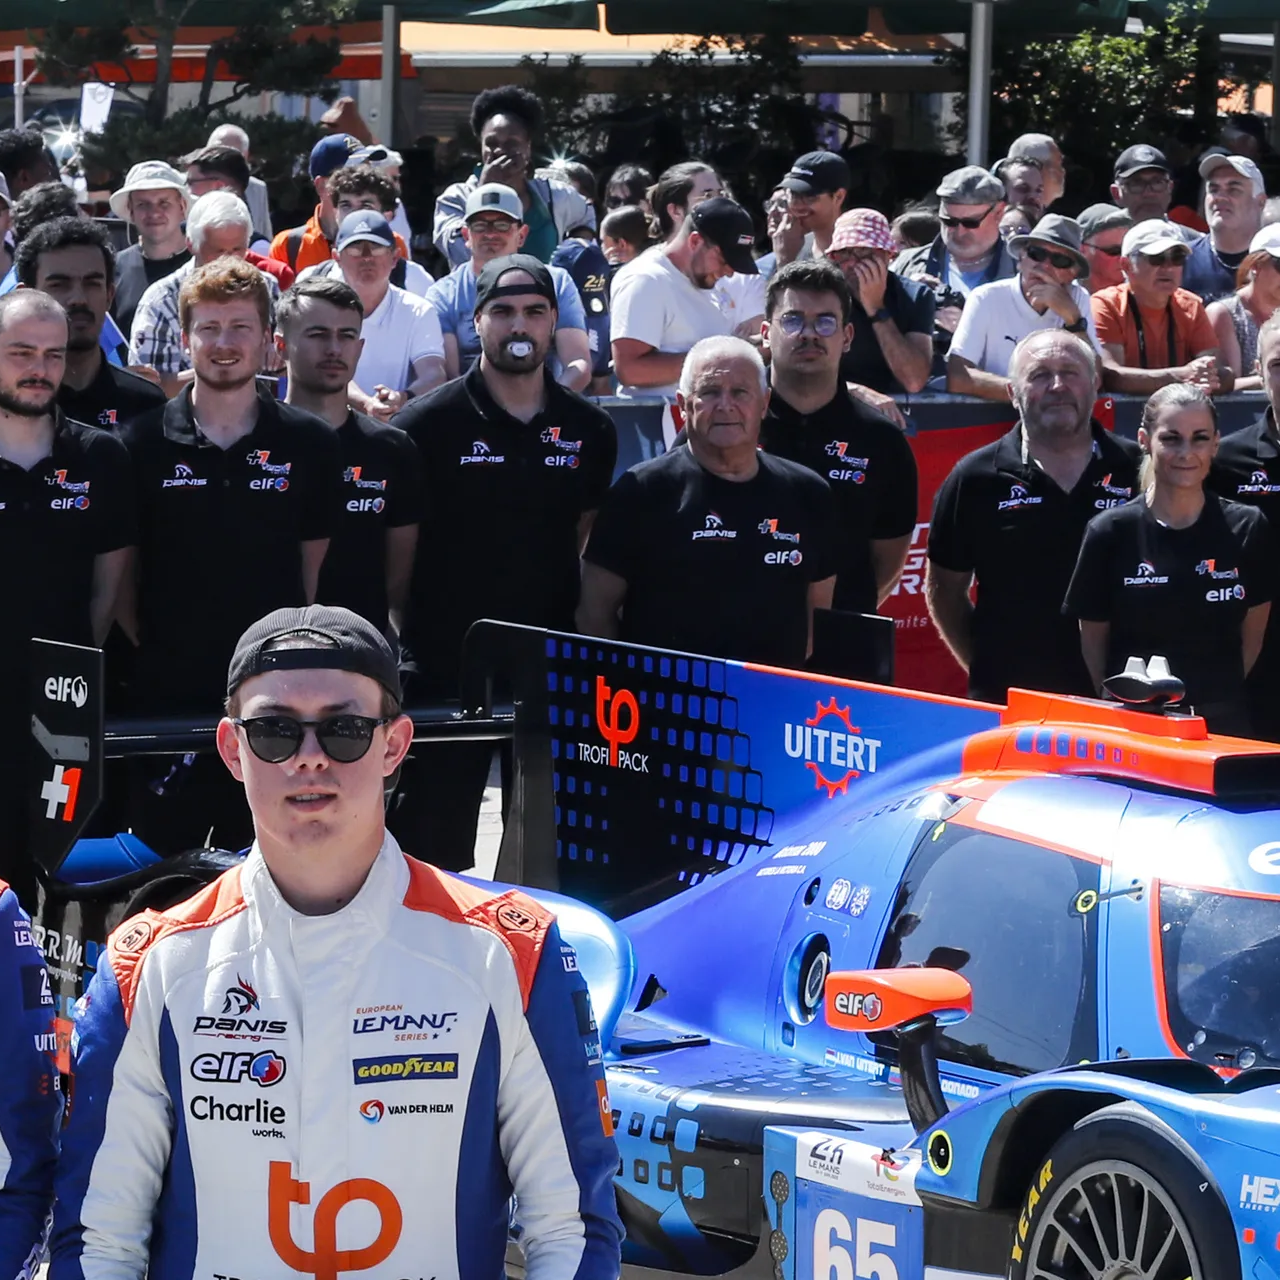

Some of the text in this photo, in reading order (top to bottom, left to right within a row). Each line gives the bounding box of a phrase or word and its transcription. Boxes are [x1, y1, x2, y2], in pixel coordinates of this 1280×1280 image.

[545, 455, 568, 467] elf
[828, 468, 853, 480] elf
[250, 478, 275, 491] elf
[51, 497, 74, 510] elf
[347, 498, 373, 512] elf
[1095, 499, 1118, 510] elf
[764, 550, 791, 565] elf
[1206, 587, 1233, 602] elf
[45, 676, 72, 701] elf
[784, 722, 882, 773] UITERT
[618, 750, 649, 774] PACK
[356, 1004, 404, 1014] EUROPEAN
[834, 992, 864, 1015] elf
[394, 1033, 428, 1042] SERIES
[192, 1052, 250, 1081] elf
[940, 1079, 980, 1099] DONADO
[190, 1095, 286, 1124] Charlie
[388, 1103, 454, 1115] VAN DER HELM
[252, 1128, 286, 1139] works.
[810, 1137, 847, 1166] 24h
[808, 1159, 820, 1169] LE
[820, 1161, 841, 1175] MANS
[866, 1180, 906, 1197] TotalEnergies
[1239, 1202, 1276, 1213] ENERGY
